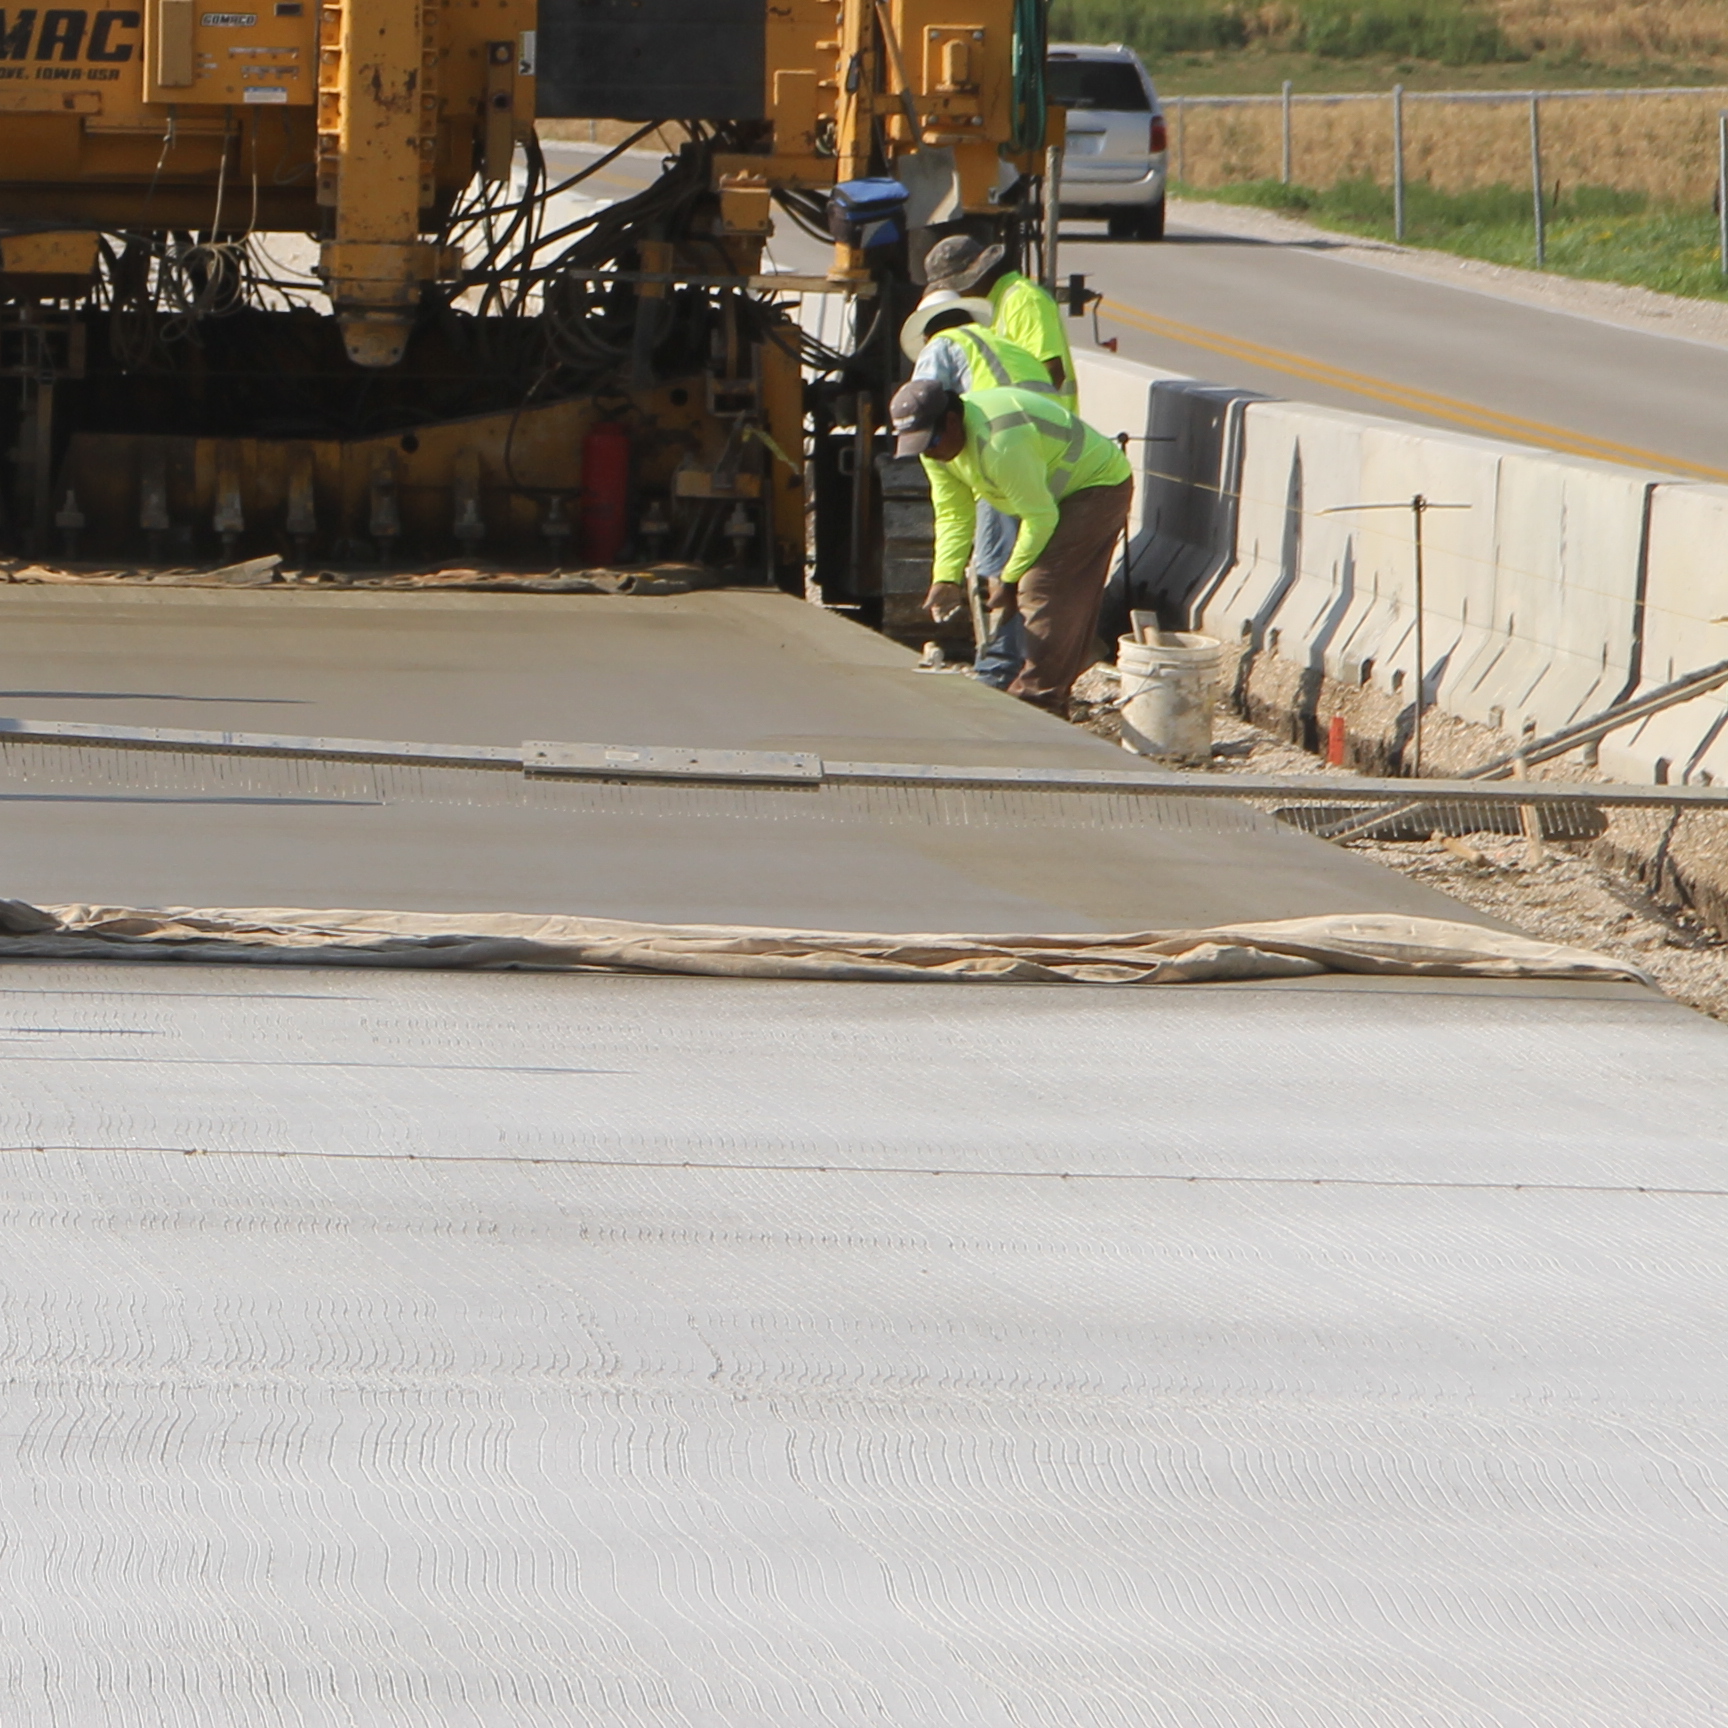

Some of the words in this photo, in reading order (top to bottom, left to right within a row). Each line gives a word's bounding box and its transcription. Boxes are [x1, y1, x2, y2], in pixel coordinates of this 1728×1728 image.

[203, 15, 256, 26] GOMACO
[35, 67, 82, 81] IOWA
[87, 68, 120, 81] USA
